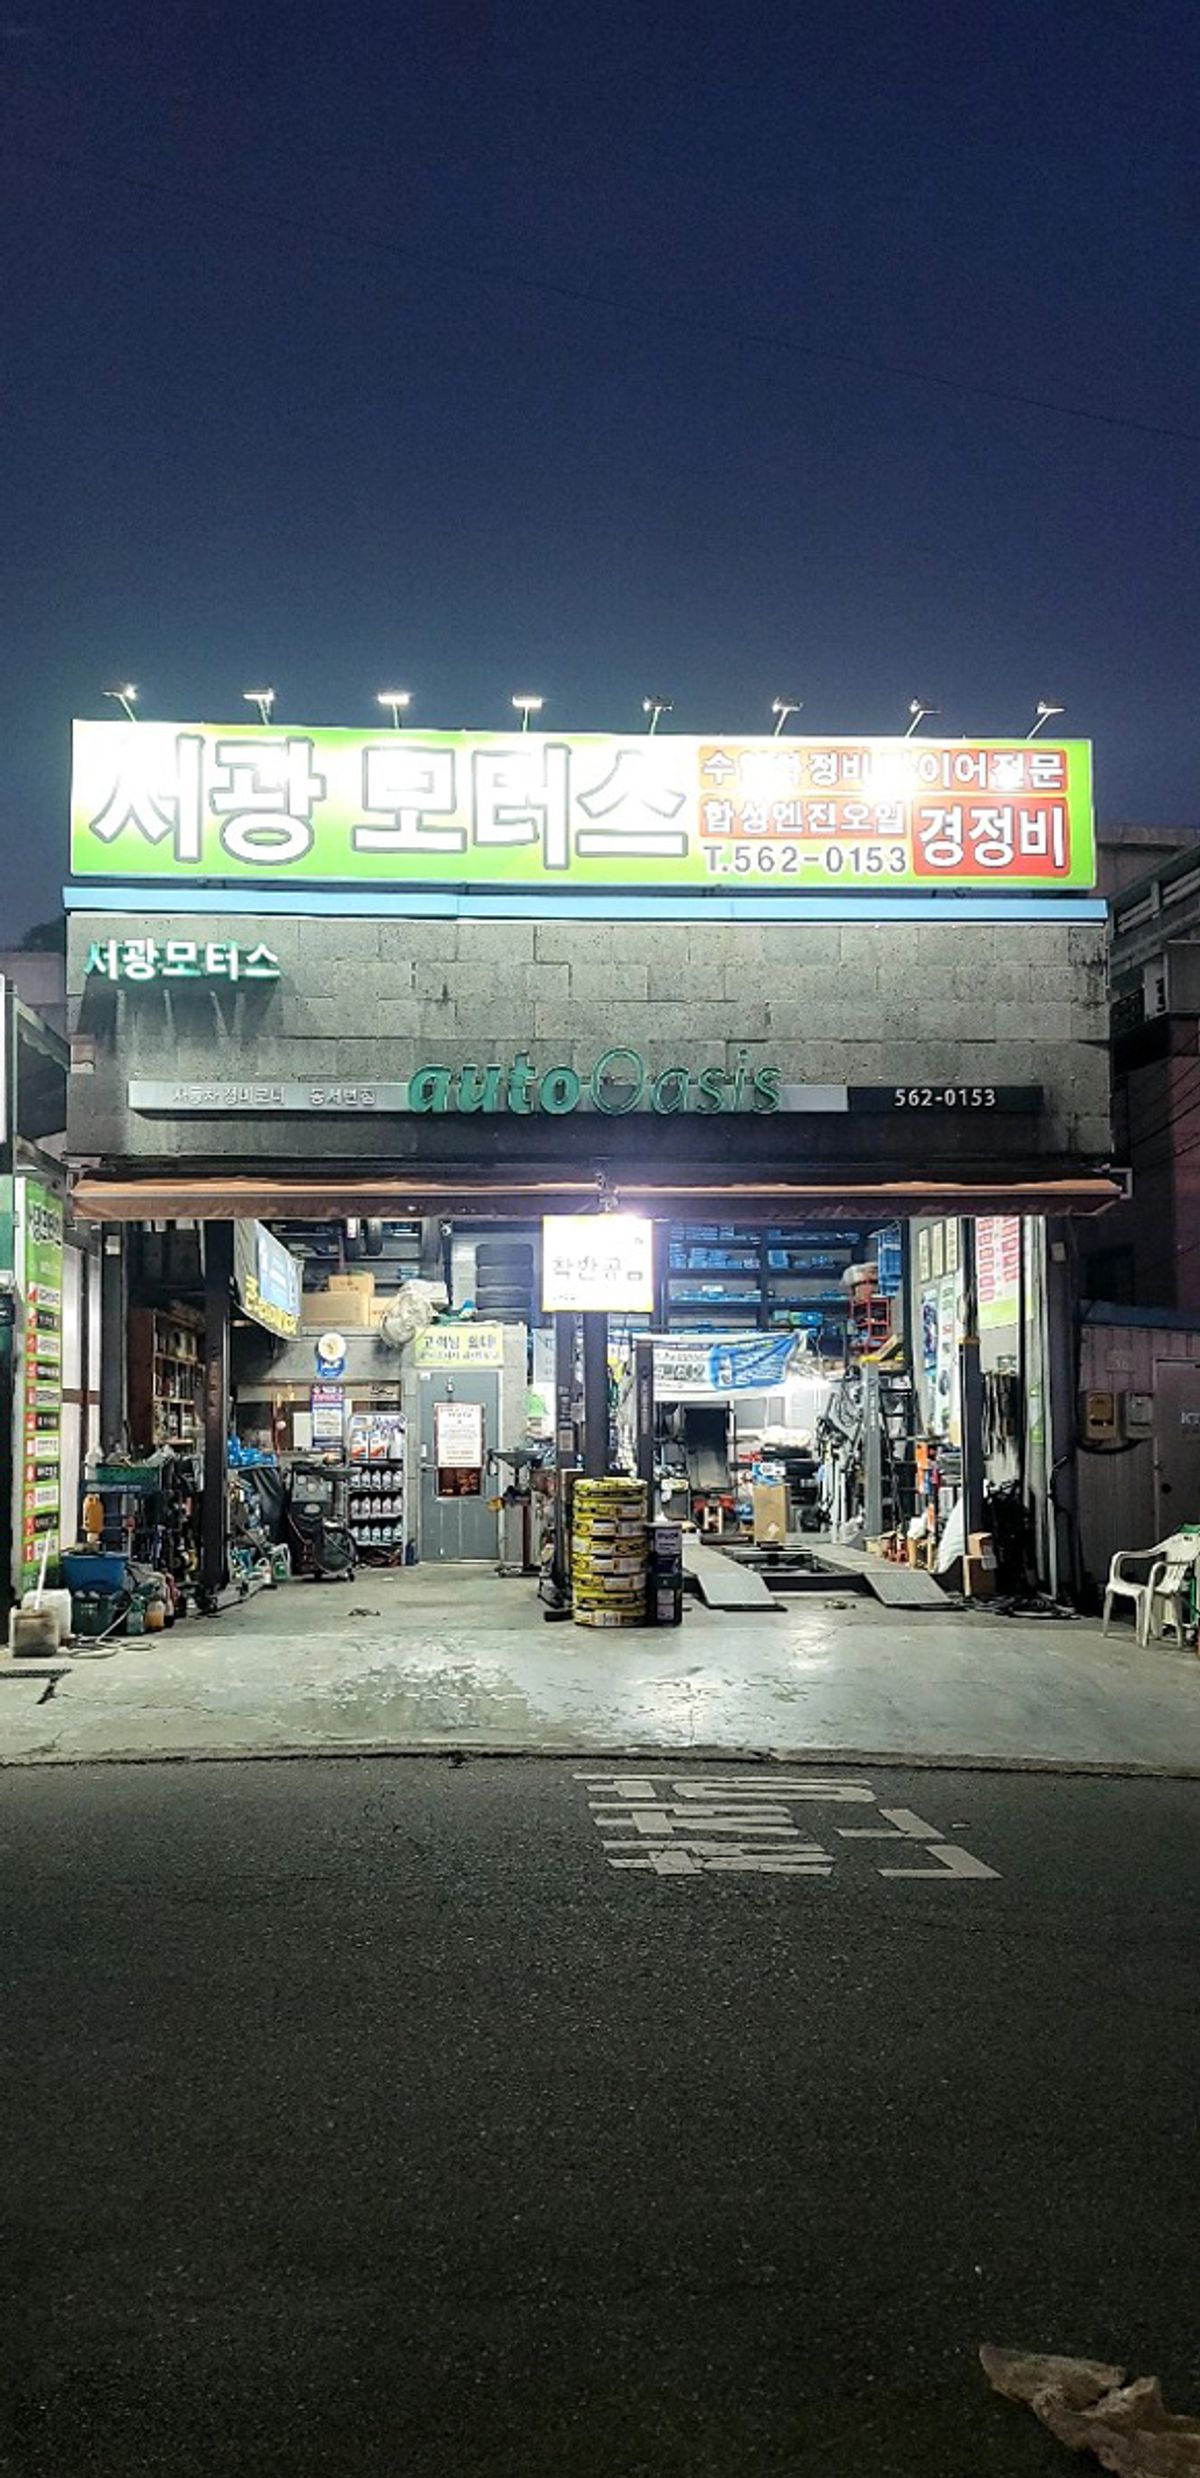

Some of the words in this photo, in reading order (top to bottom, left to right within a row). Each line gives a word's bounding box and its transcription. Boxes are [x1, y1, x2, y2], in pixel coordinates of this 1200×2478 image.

[89, 732, 327, 866] 서광
[351, 742, 689, 871] 모터스
[702, 799, 906, 834] 합성엔진오일
[917, 804, 1065, 868] 경정비
[702, 844, 907, 874] T.562-0153
[84, 937, 281, 981] 서광모터스
[894, 1086, 997, 1107] 562-0153
